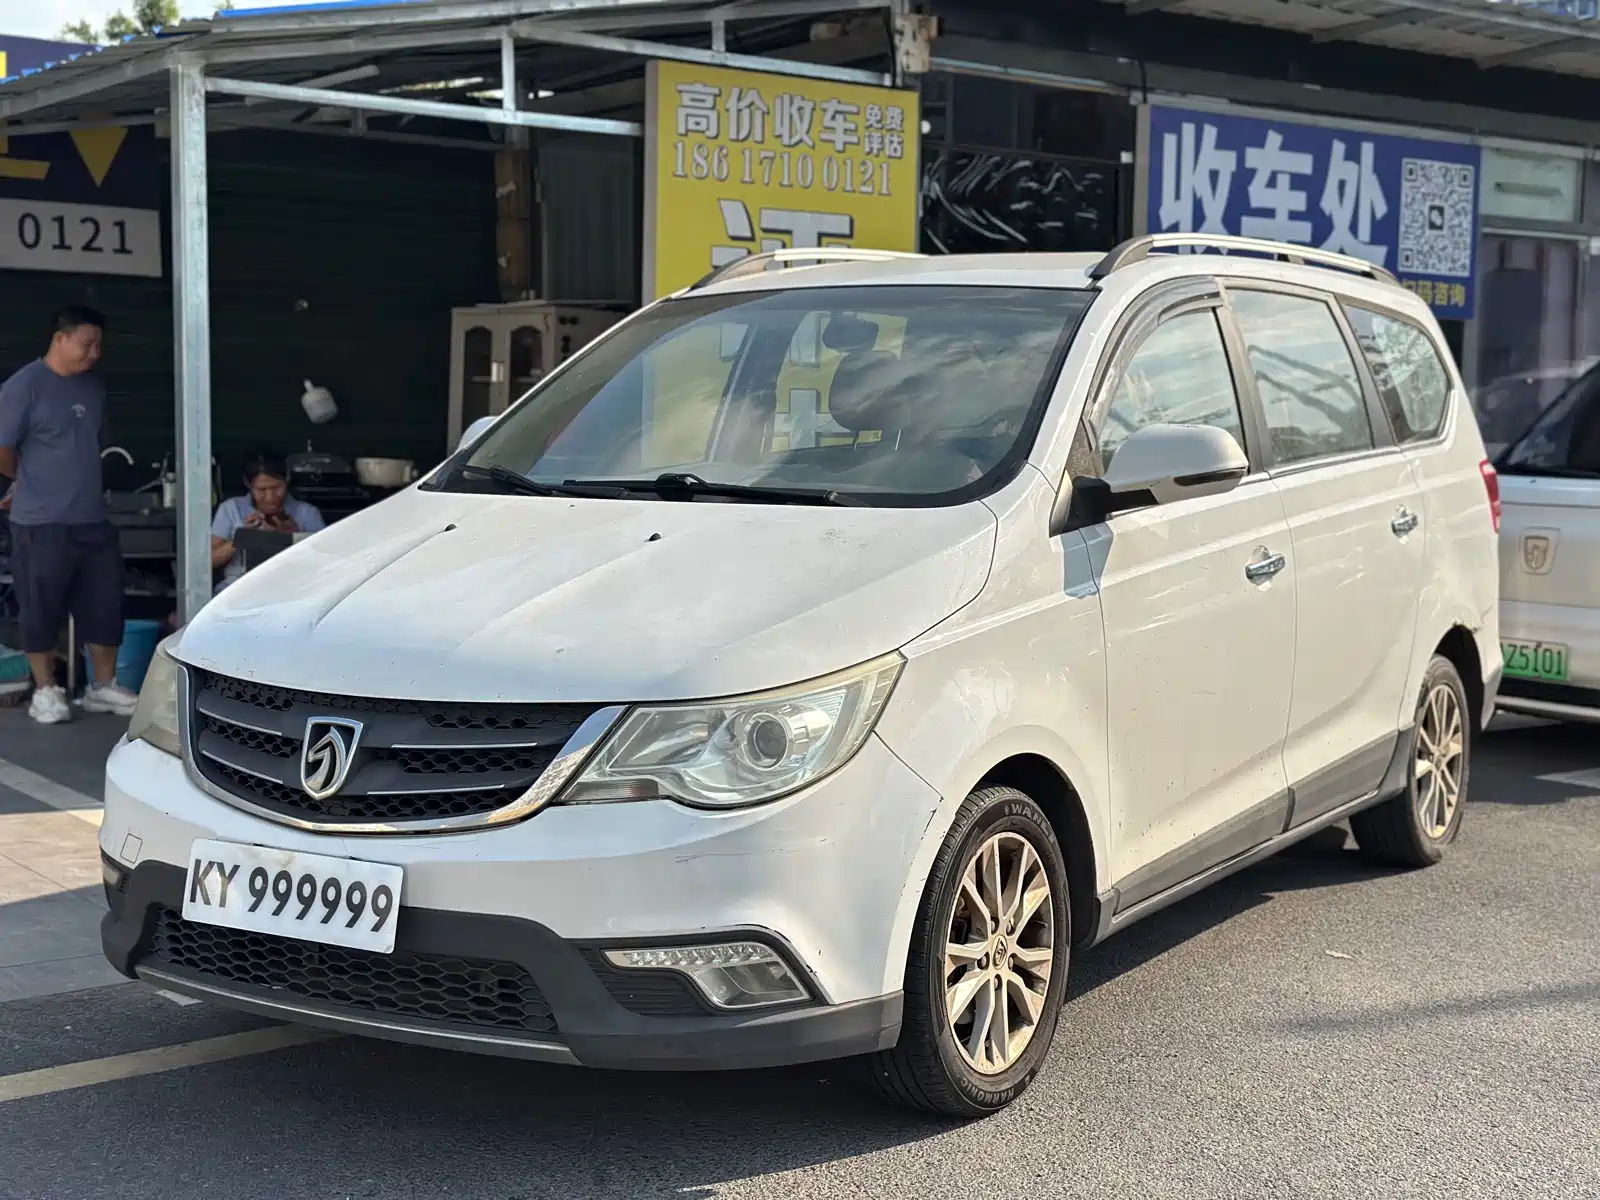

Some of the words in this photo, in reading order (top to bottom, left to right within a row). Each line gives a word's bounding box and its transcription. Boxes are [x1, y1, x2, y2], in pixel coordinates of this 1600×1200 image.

[676, 82, 860, 152] 高价收车
[865, 104, 903, 131] 免费
[673, 140, 729, 181] 186
[740, 147, 813, 189] 1710
[823, 156, 892, 196] 0121
[864, 132, 903, 159] 评估
[1159, 121, 1388, 266] 收车处
[18, 212, 133, 254] 0121
[1500, 642, 1562, 675] Z5101
[189, 858, 241, 908] KY
[247, 866, 393, 932] 999999
